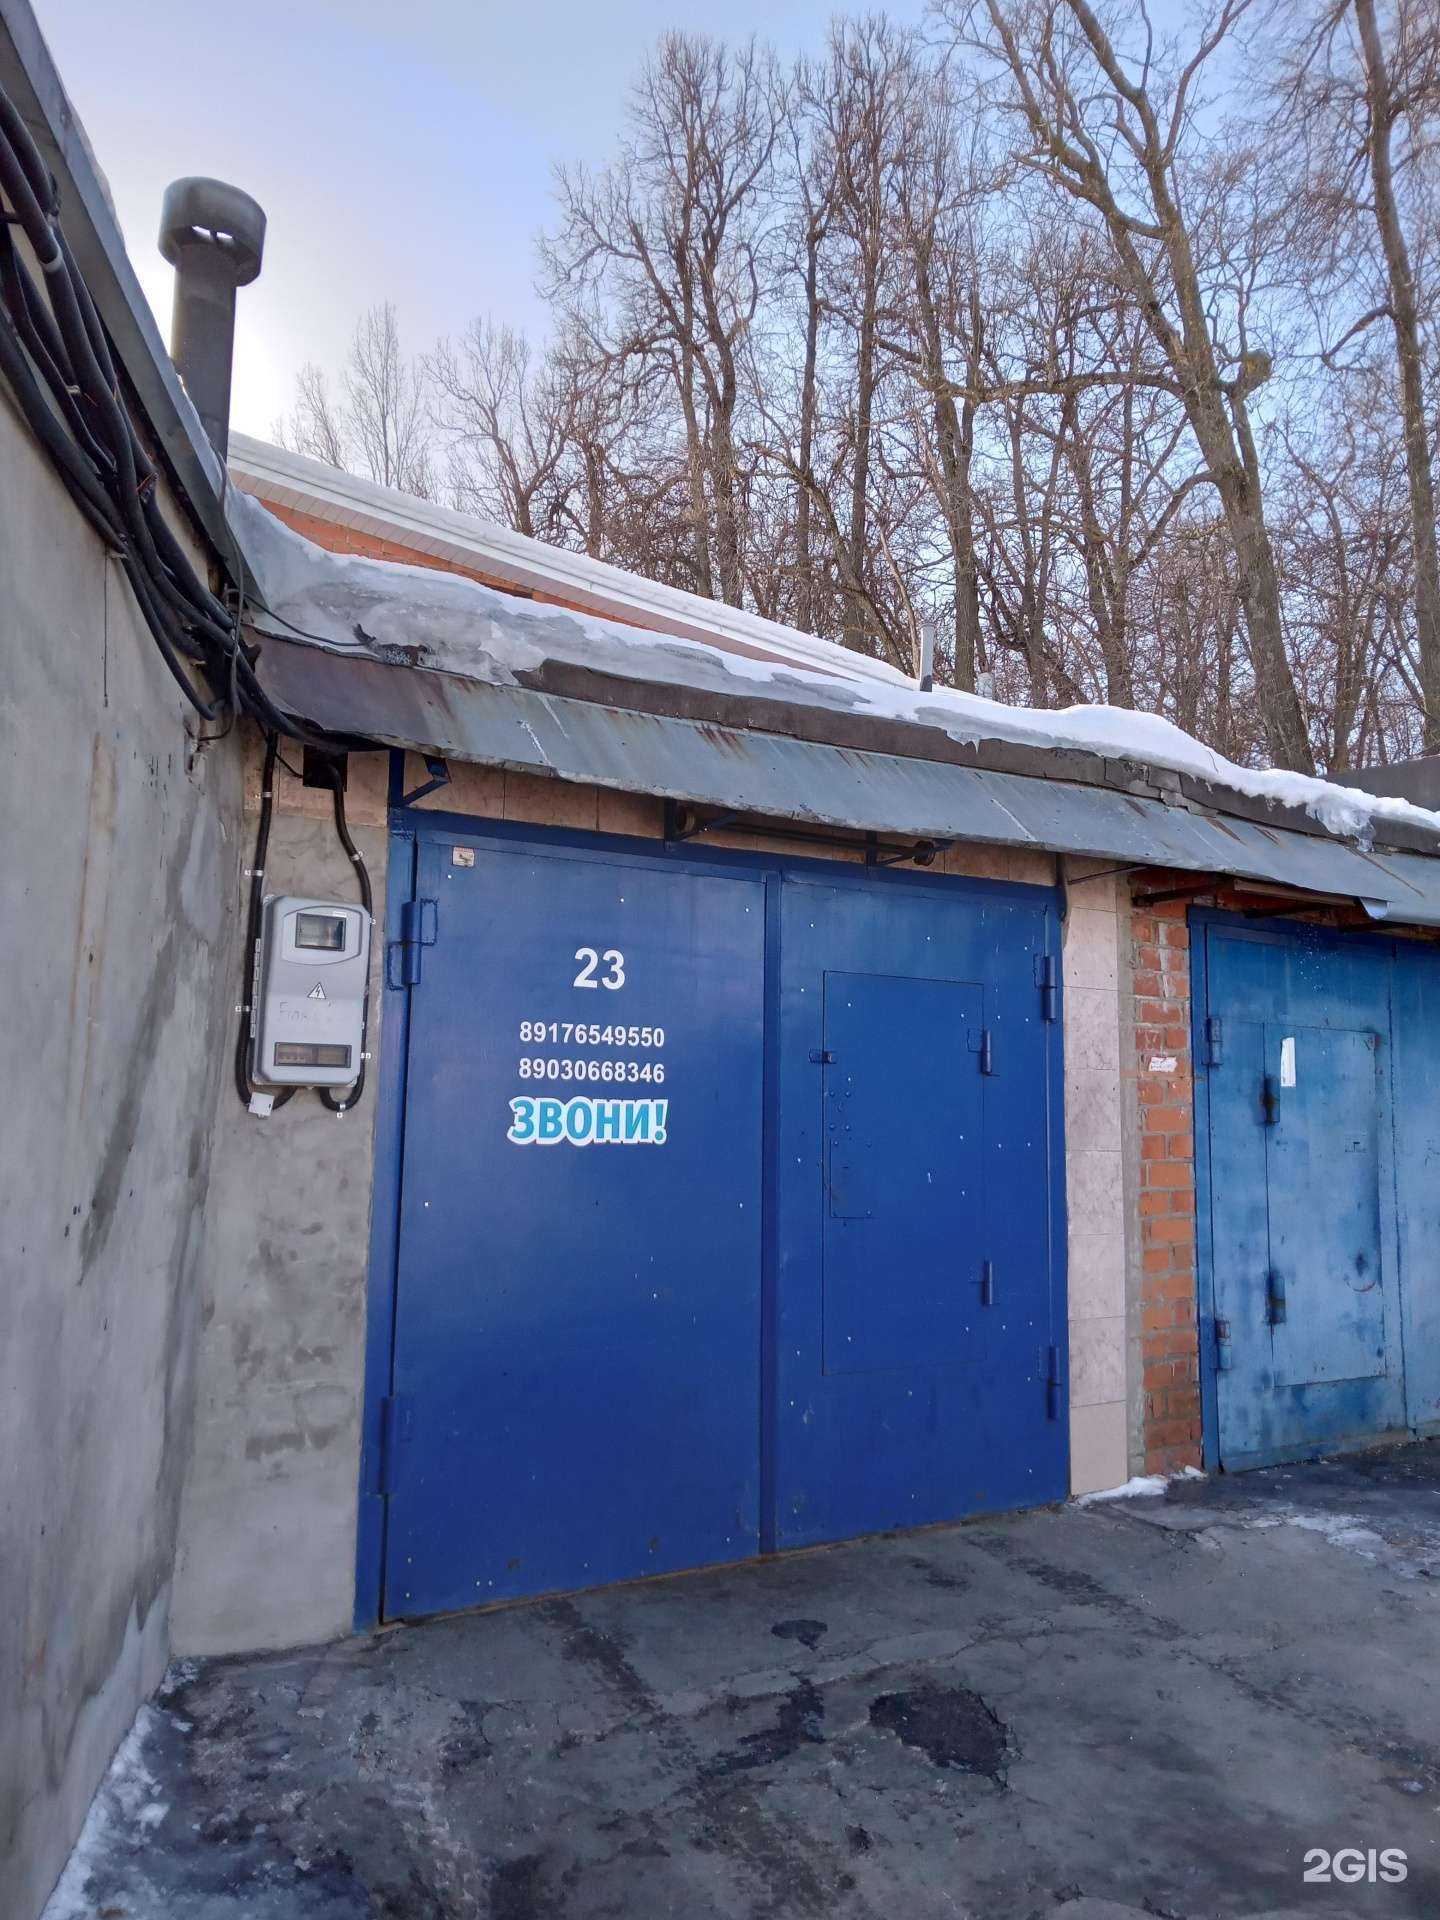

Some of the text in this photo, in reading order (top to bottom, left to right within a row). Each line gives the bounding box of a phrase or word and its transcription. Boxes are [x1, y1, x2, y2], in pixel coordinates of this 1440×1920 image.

[573, 947, 626, 990] 23
[519, 1021, 665, 1048] 89176549550
[518, 1057, 666, 1084] 89030668346
[508, 1097, 667, 1145] ЗВОНИ!
